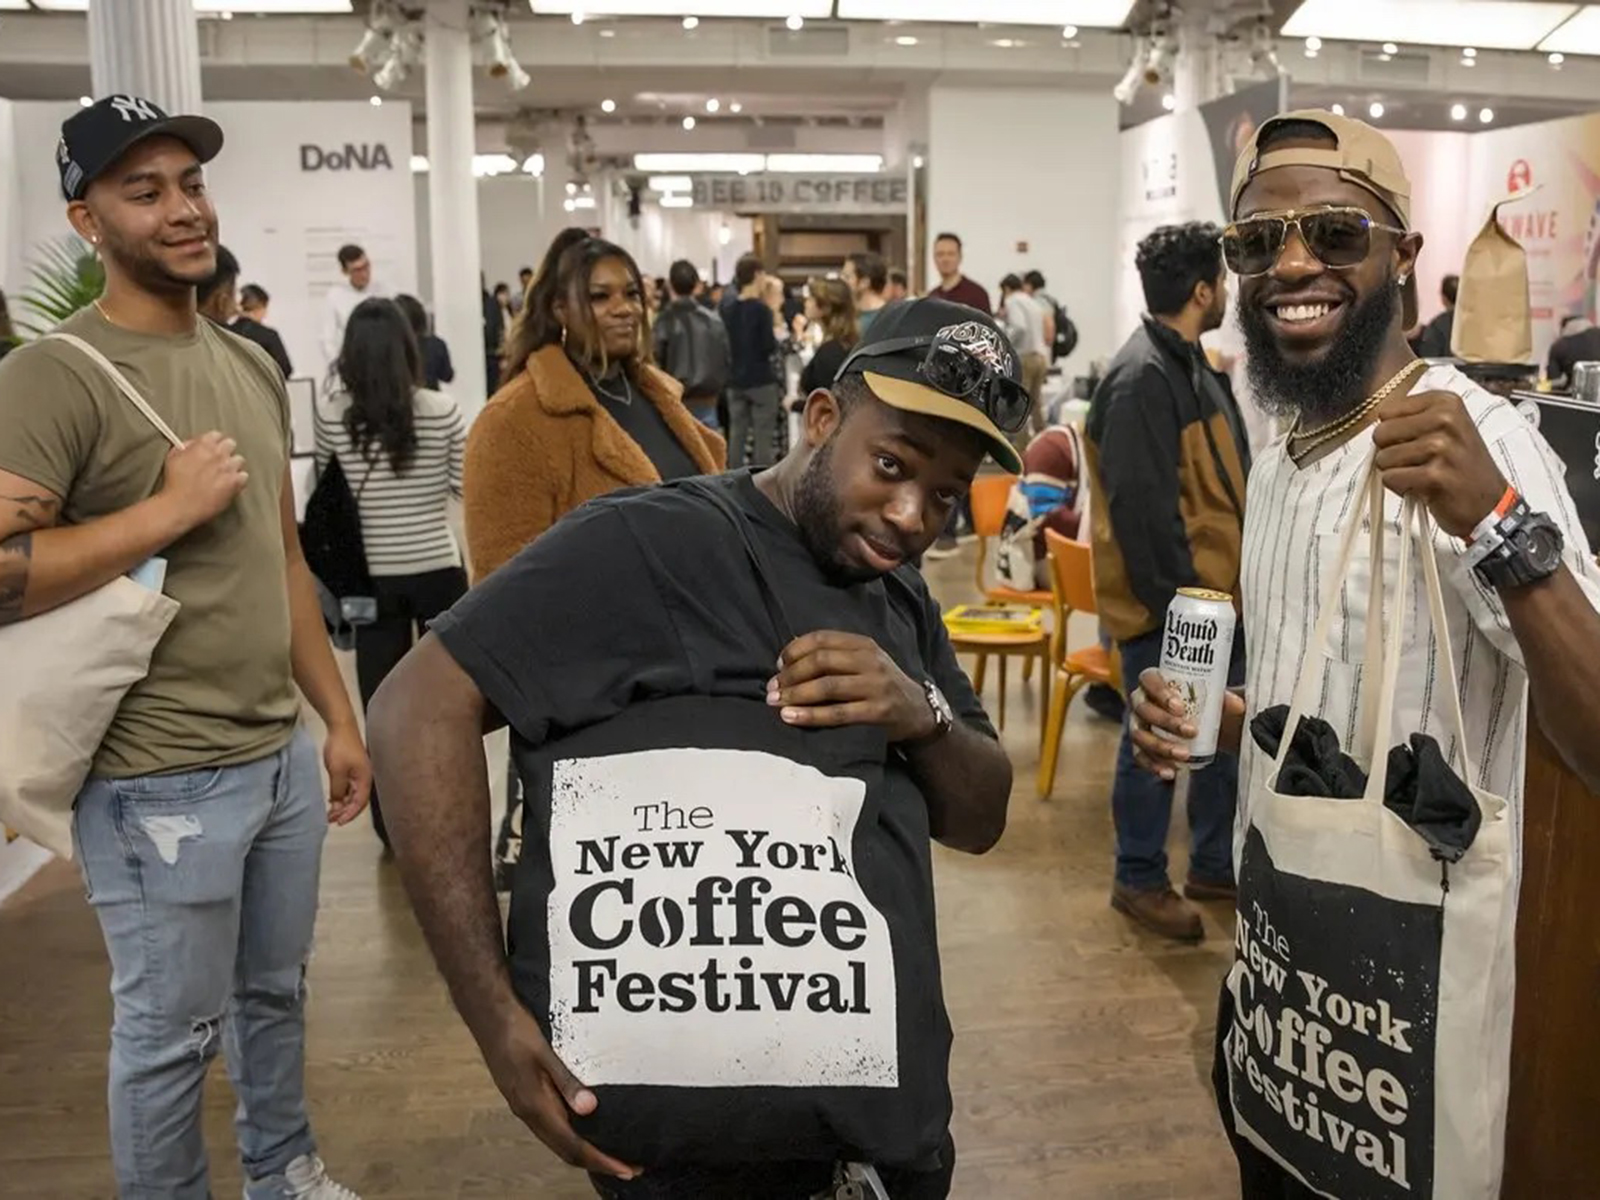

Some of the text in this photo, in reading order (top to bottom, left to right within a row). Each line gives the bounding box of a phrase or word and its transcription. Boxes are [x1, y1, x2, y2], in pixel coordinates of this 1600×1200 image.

[299, 143, 394, 171] DoNA
[1166, 635, 1214, 665] Death
[1168, 610, 1218, 643] Liquid
[633, 802, 714, 831] The
[574, 835, 704, 875] New
[568, 875, 868, 951] Coffee
[1253, 901, 1290, 963] The
[572, 956, 871, 1014] Festival
[1234, 909, 1413, 1053] New York
[1234, 959, 1410, 1126] Coffee
[1231, 1018, 1412, 1190] Festival
